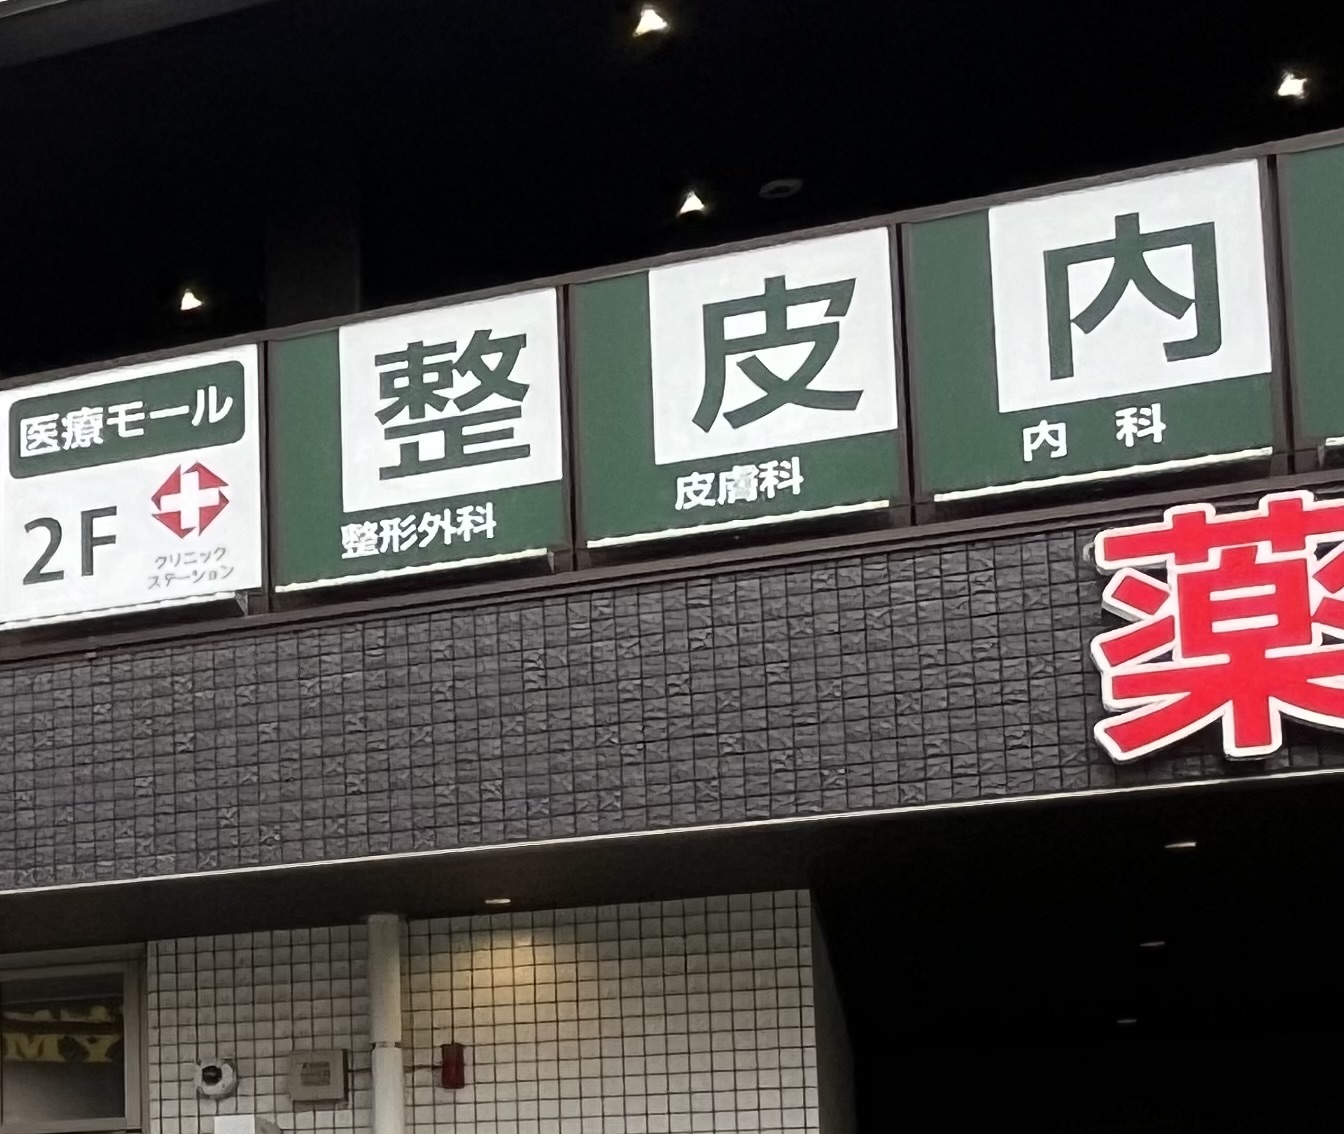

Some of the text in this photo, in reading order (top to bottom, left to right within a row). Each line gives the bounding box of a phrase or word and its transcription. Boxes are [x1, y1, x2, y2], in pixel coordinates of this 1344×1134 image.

[1043, 212, 1222, 381] 内
[691, 274, 864, 433] 皮
[19, 385, 234, 458] 医療モール
[374, 328, 531, 480] 整
[674, 456, 805, 511] 皮膚科
[22, 505, 118, 586] 2F
[153, 546, 227, 569] クリニック
[339, 501, 497, 560] 整形外科
[1090, 490, 1344, 761] 薬
